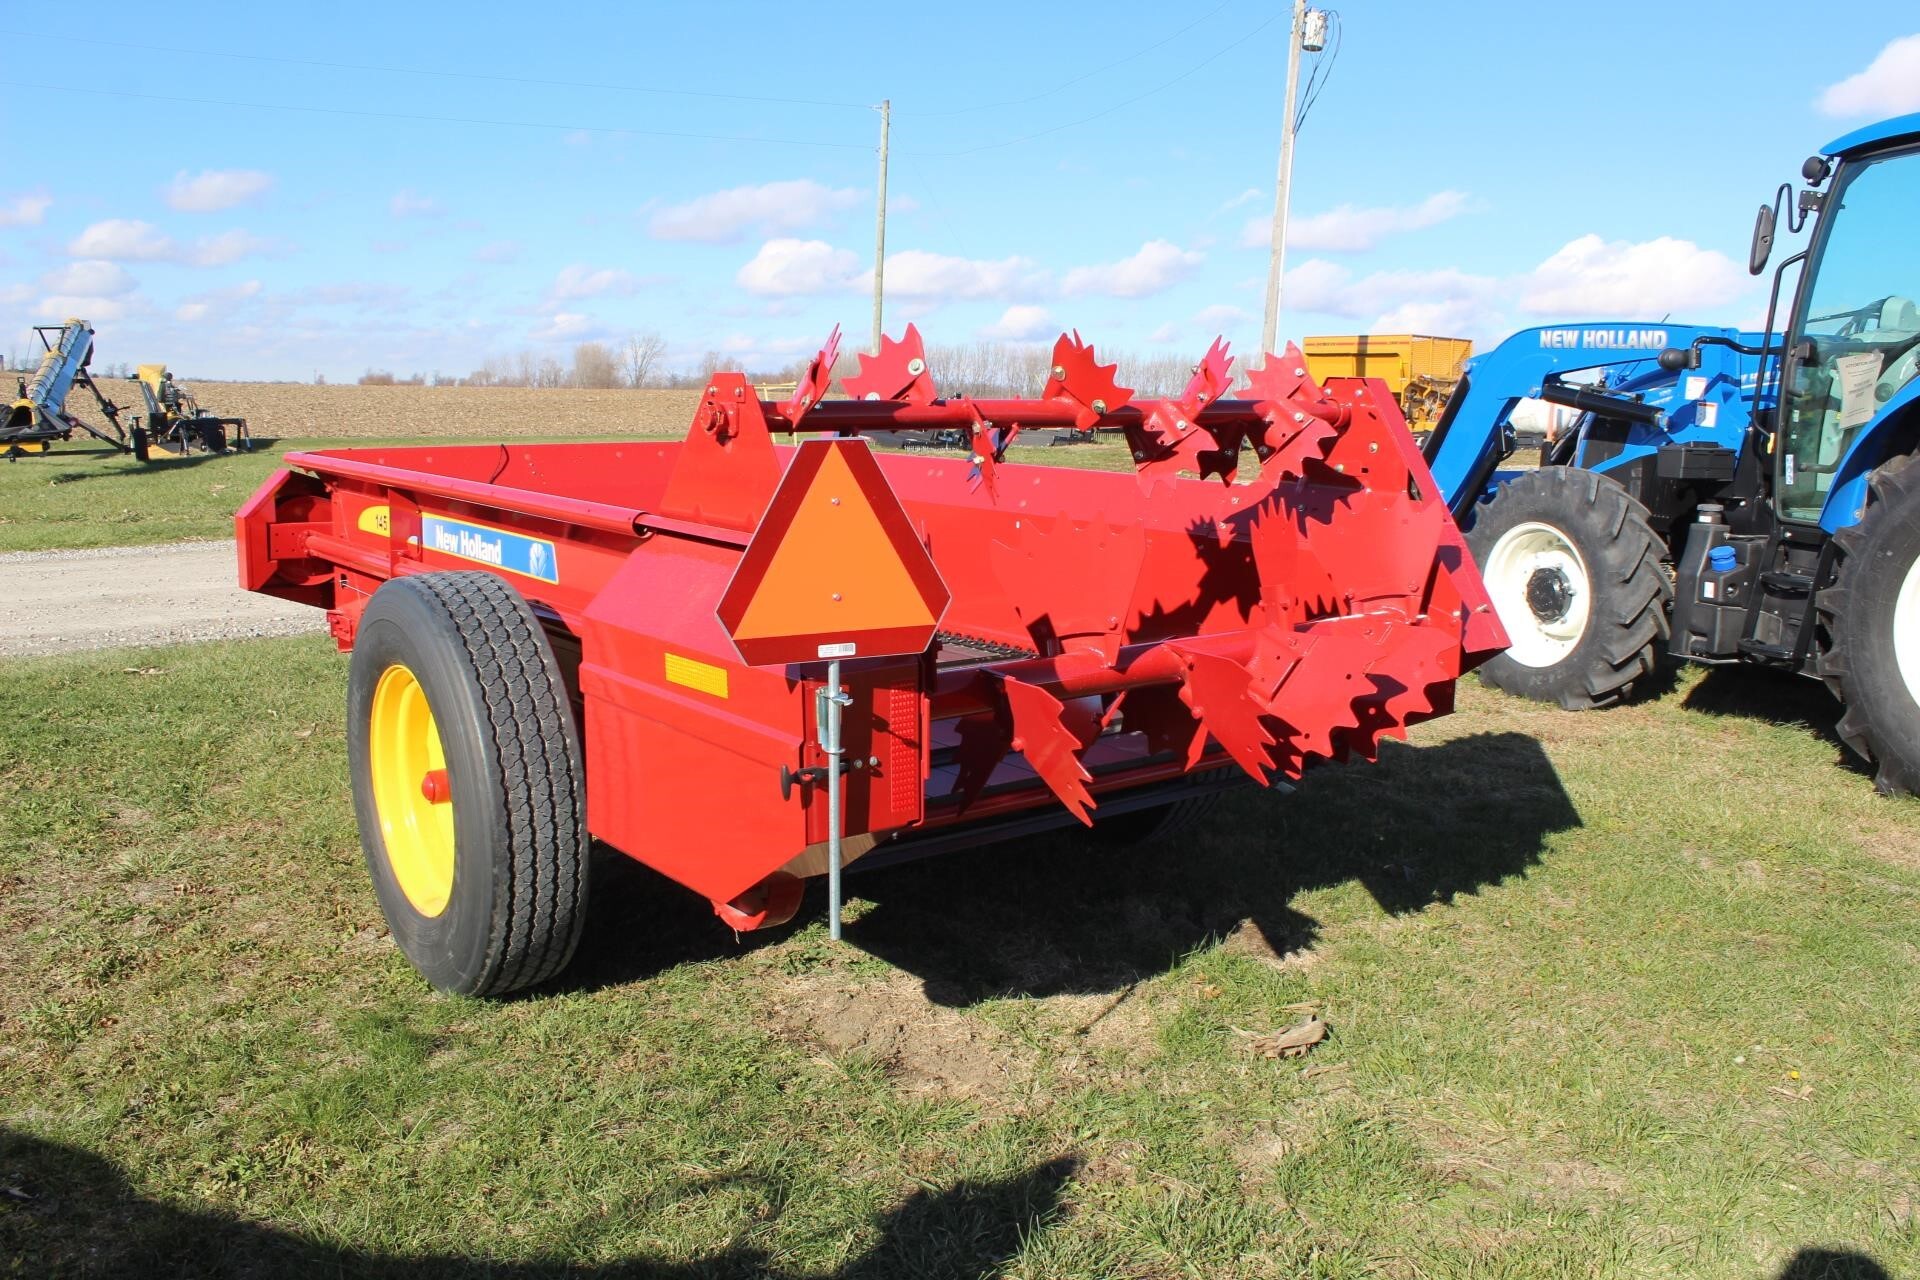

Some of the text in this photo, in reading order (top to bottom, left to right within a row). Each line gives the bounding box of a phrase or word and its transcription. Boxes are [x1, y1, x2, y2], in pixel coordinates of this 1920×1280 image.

[1539, 329, 1668, 349] NEW HOLLAND
[435, 525, 502, 565] New Holland
